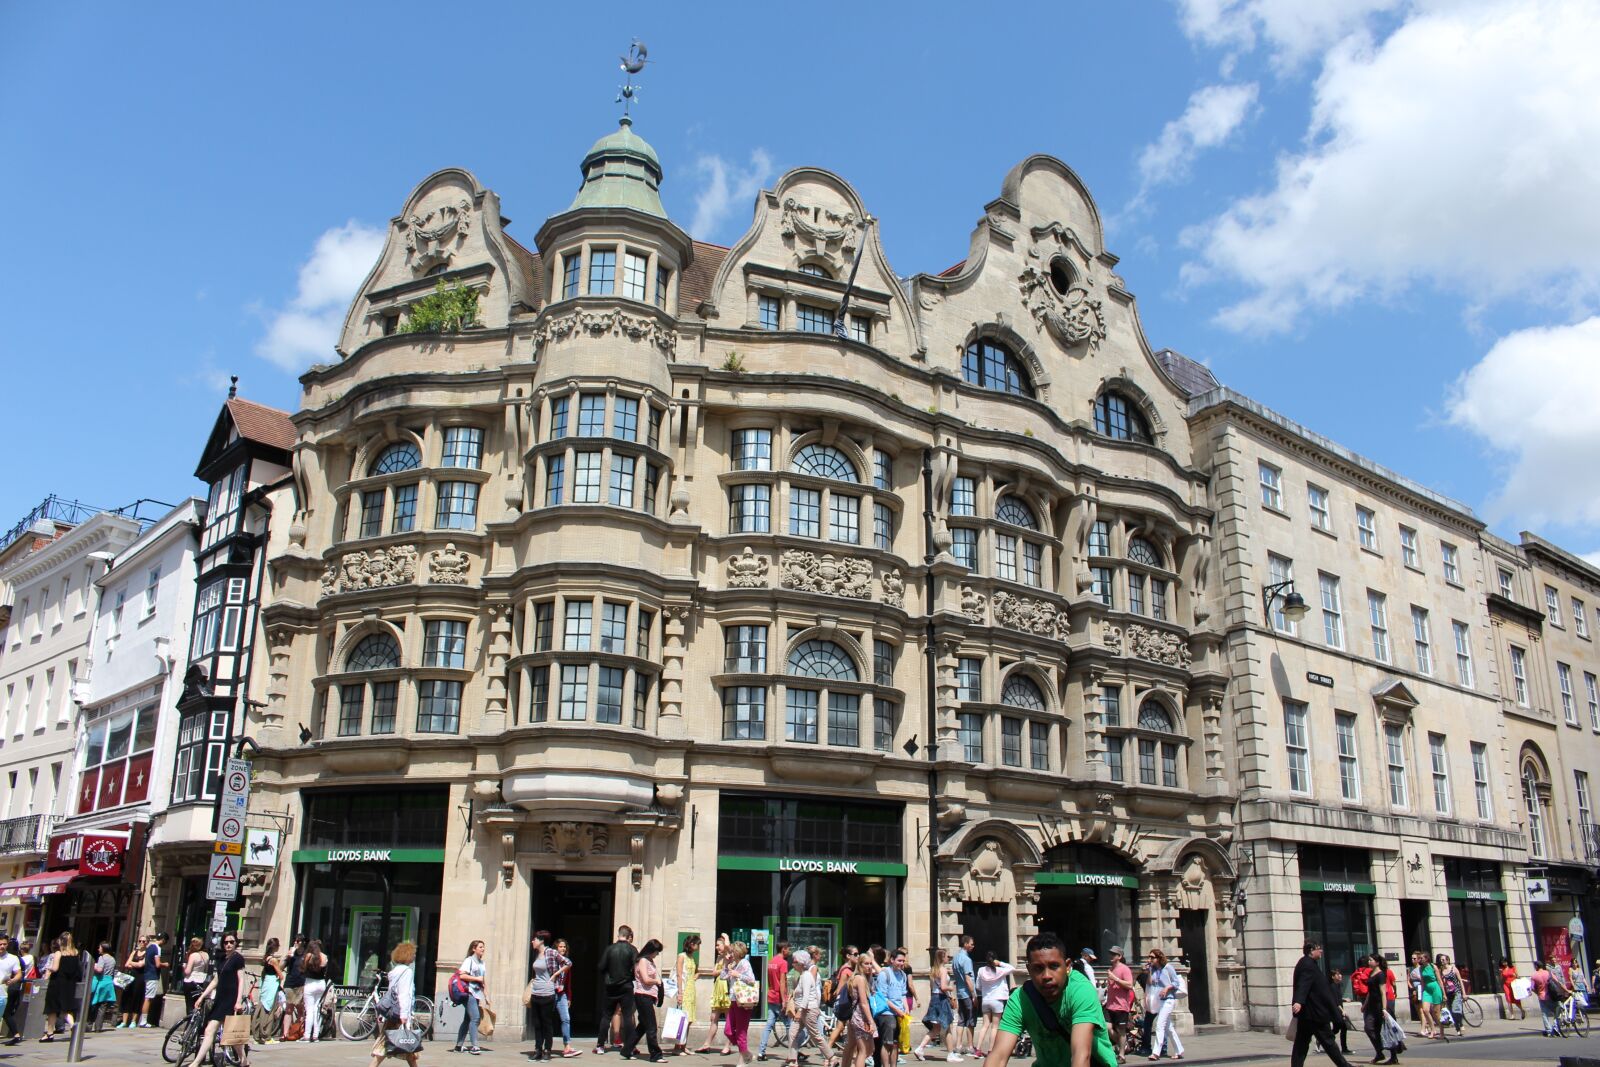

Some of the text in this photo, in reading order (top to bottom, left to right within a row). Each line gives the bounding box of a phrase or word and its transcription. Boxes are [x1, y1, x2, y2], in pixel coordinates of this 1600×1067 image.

[230, 764, 248, 772] ZONE
[328, 850, 391, 861] LLOYDS BANK
[779, 859, 857, 873] LLOYDS BANK
[1076, 874, 1124, 886] LLOYDS BANK
[1323, 882, 1356, 893] LLOYDS BANK
[1466, 890, 1491, 900] LLOYDS BANK
